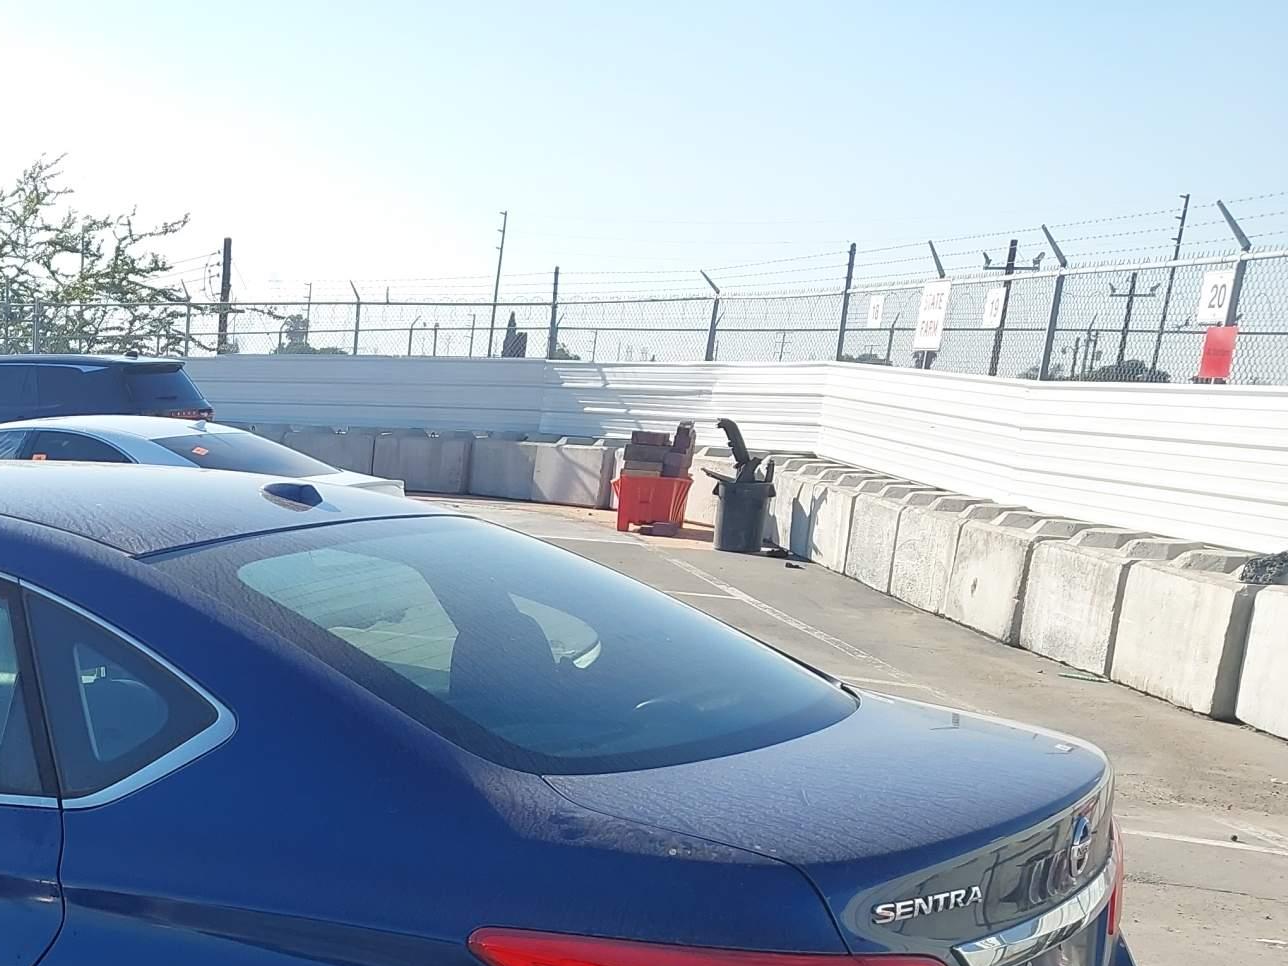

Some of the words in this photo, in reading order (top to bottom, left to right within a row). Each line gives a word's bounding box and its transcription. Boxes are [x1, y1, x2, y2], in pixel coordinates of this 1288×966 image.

[923, 292, 945, 311] STATE
[1207, 283, 1227, 309] 20
[989, 297, 1000, 318] 19
[919, 319, 939, 337] FARM
[872, 886, 983, 925] SENTRA
